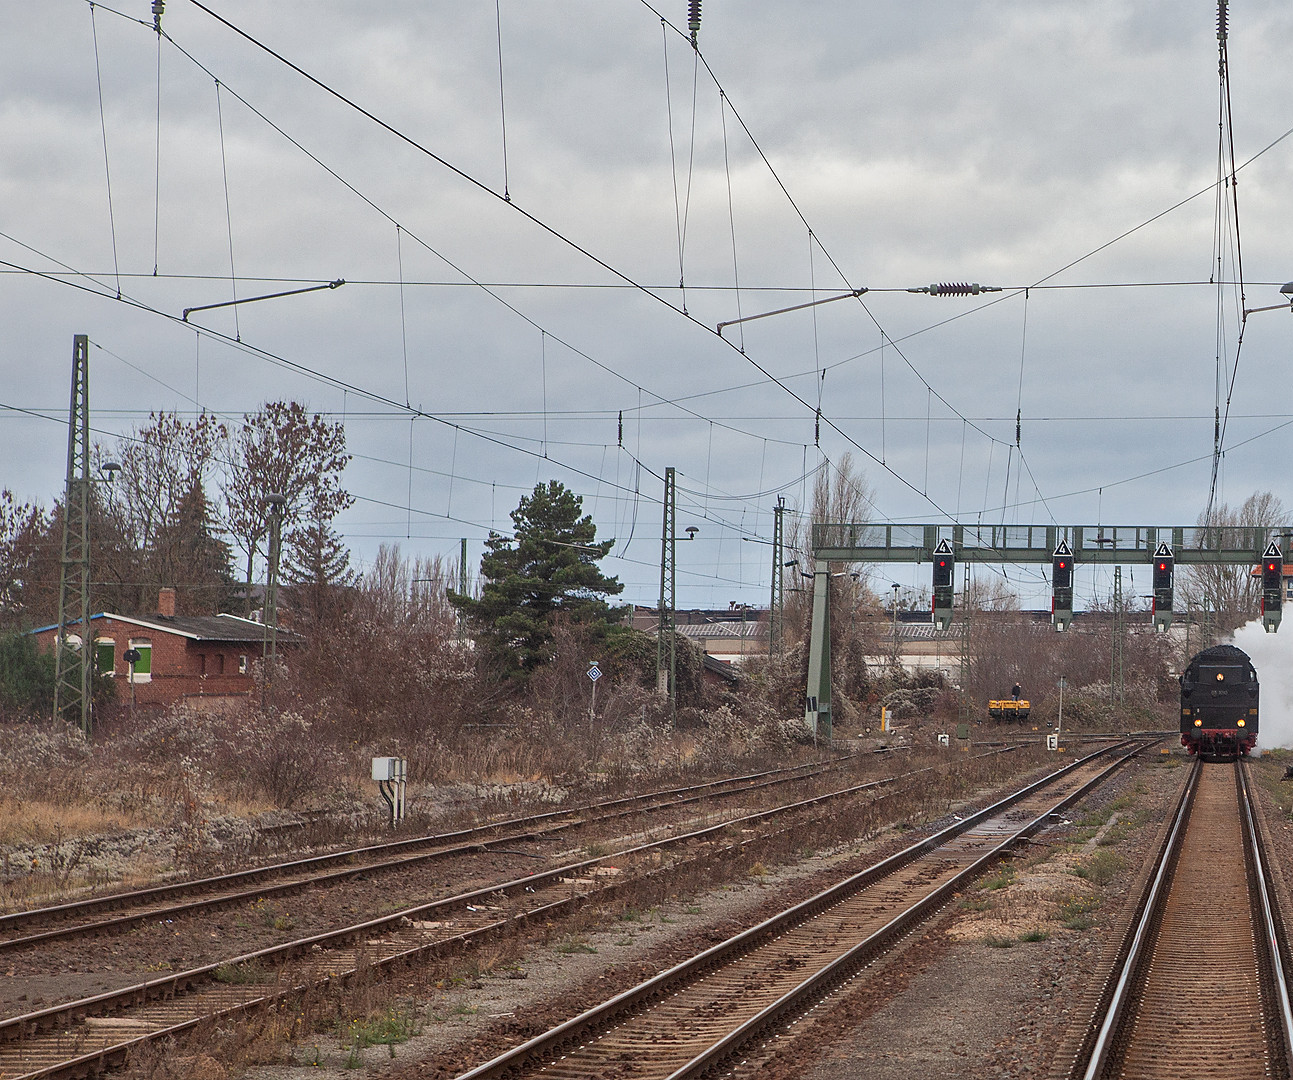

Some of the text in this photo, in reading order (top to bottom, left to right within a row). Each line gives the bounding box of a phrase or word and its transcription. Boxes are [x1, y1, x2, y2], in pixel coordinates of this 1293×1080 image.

[939, 542, 946, 553] 4
[1059, 543, 1066, 554] 4
[1160, 545, 1167, 556] 4
[1268, 545, 1276, 556] 4
[1049, 736, 1056, 748] E
